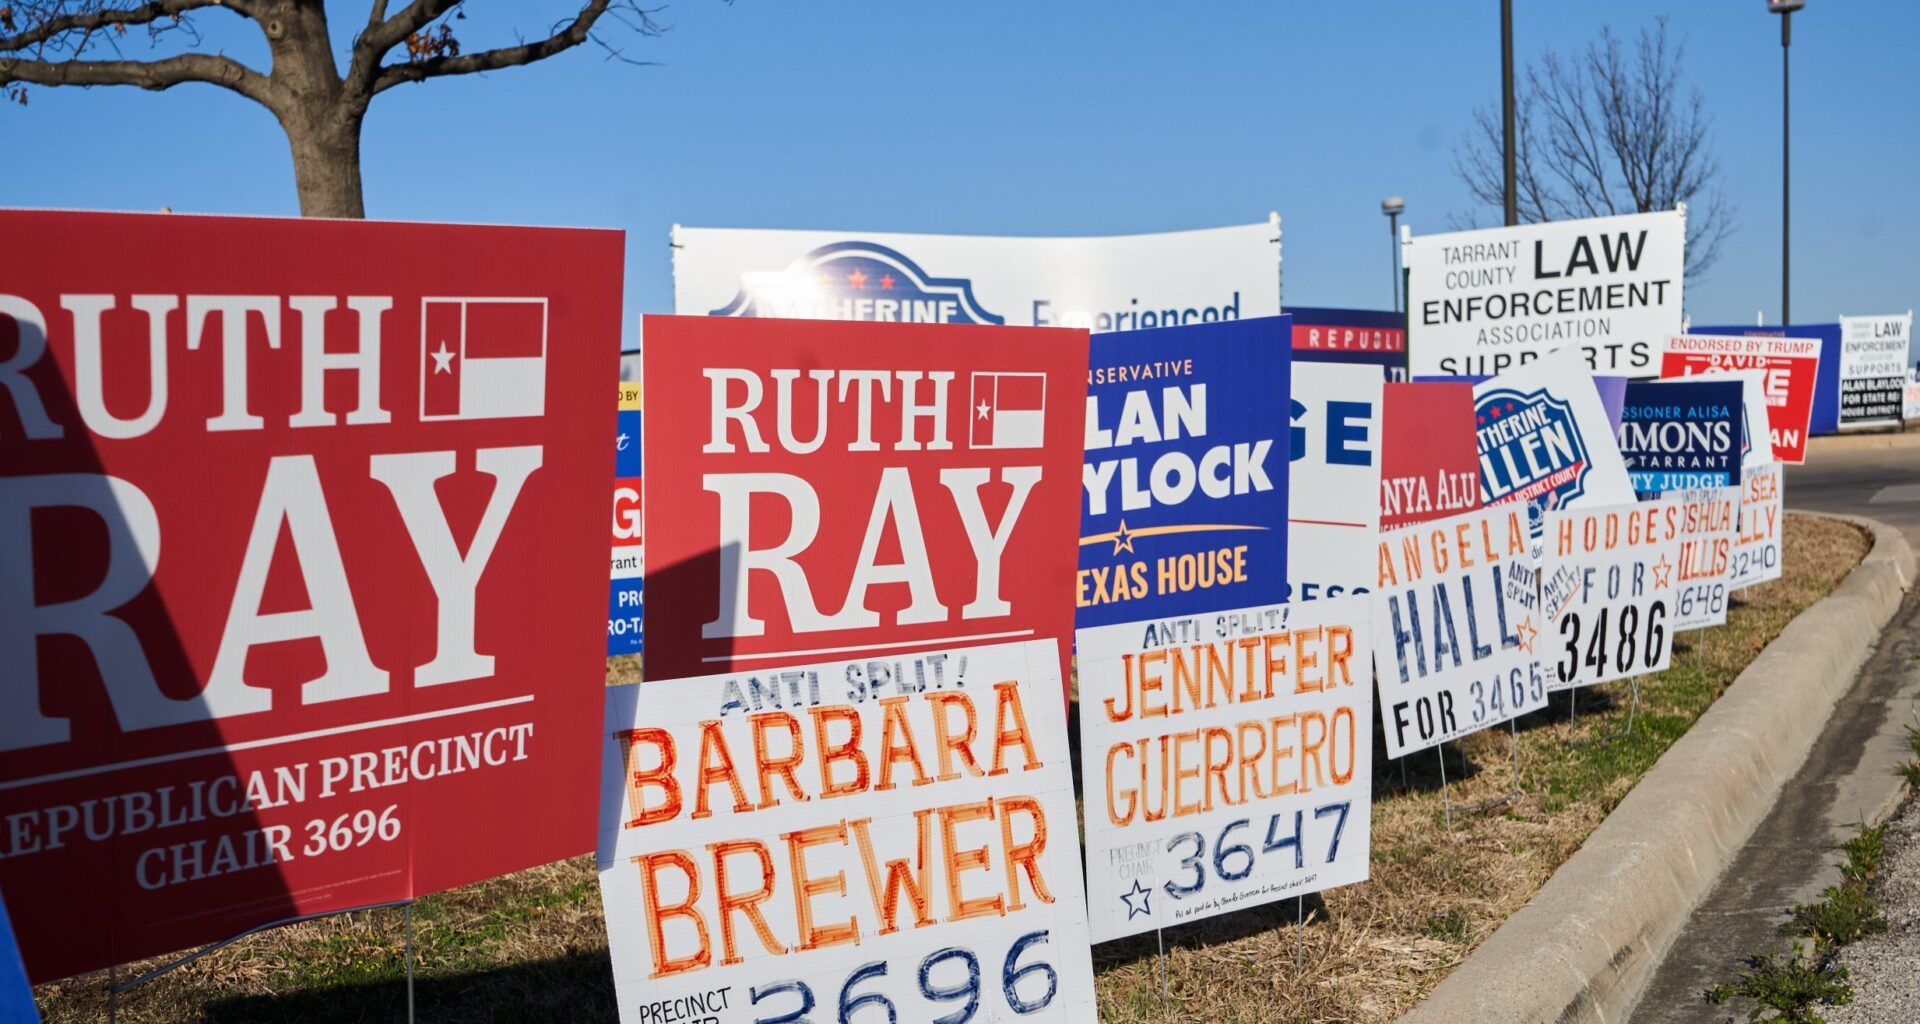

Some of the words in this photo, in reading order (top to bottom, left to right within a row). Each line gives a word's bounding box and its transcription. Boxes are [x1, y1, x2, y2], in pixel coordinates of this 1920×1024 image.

[1442, 240, 1521, 266] TARRANT
[1534, 230, 1648, 279] LAW
[1445, 266, 1516, 290] COUNTY
[1423, 280, 1671, 325] ENFORCEMENT
[1477, 318, 1611, 346] ASSOCIATION
[1670, 338, 1742, 351] ENDORSED
[1746, 341, 1763, 351] BY
[1766, 341, 1814, 354] TRUMP
[1845, 341, 1906, 353] ENFORCEMENT
[1875, 321, 1902, 338] LAW
[1710, 355, 1767, 368] DAVID
[1848, 362, 1902, 375] SUPPORTS
[626, 391, 638, 401] BY
[1842, 380, 1866, 392] ALAN
[1843, 394, 1861, 405] FOR
[1862, 392, 1886, 404] STATE
[702, 367, 955, 455] RUTH
[1084, 383, 1206, 450] LAN
[1688, 405, 1730, 418] ALISA
[1082, 439, 1273, 515] YLOCK
[1550, 466, 1577, 488] COURT
[1639, 456, 1728, 468] TARRANT
[1660, 473, 1725, 490] JUDGE
[1379, 476, 1432, 516] NYA
[702, 466, 1042, 639] RAY
[1378, 512, 1525, 588] ANGELA
[1558, 505, 1677, 556] HODGES
[1076, 561, 1148, 608] EXAS
[1157, 545, 1248, 595] HOUSE
[1677, 538, 1729, 581] ILLIS
[1730, 544, 1776, 579] 3240
[0, 445, 543, 751] RAY
[1507, 582, 1536, 611] SPLIT
[1582, 561, 1645, 604] FOR
[1143, 619, 1200, 649] ANTI
[1216, 607, 1289, 638] SPLIT!
[1388, 565, 1520, 684] HALL
[1557, 600, 1666, 683] 3486
[720, 670, 821, 716] ANTI
[1103, 624, 1354, 722] JENNIFER
[1392, 689, 1457, 748] FOR
[1469, 661, 1544, 723] 3465
[613, 679, 1044, 829] BARBARA
[1106, 706, 1355, 827] GUERRERO
[0, 764, 309, 859] EPUBLICAN
[319, 723, 533, 799] PRECINCT
[136, 827, 294, 891] CHAIR
[303, 805, 401, 857] 3696
[1164, 800, 1352, 900] 3647
[630, 795, 1056, 980] BREWER
[639, 986, 731, 1024] PRECINCT
